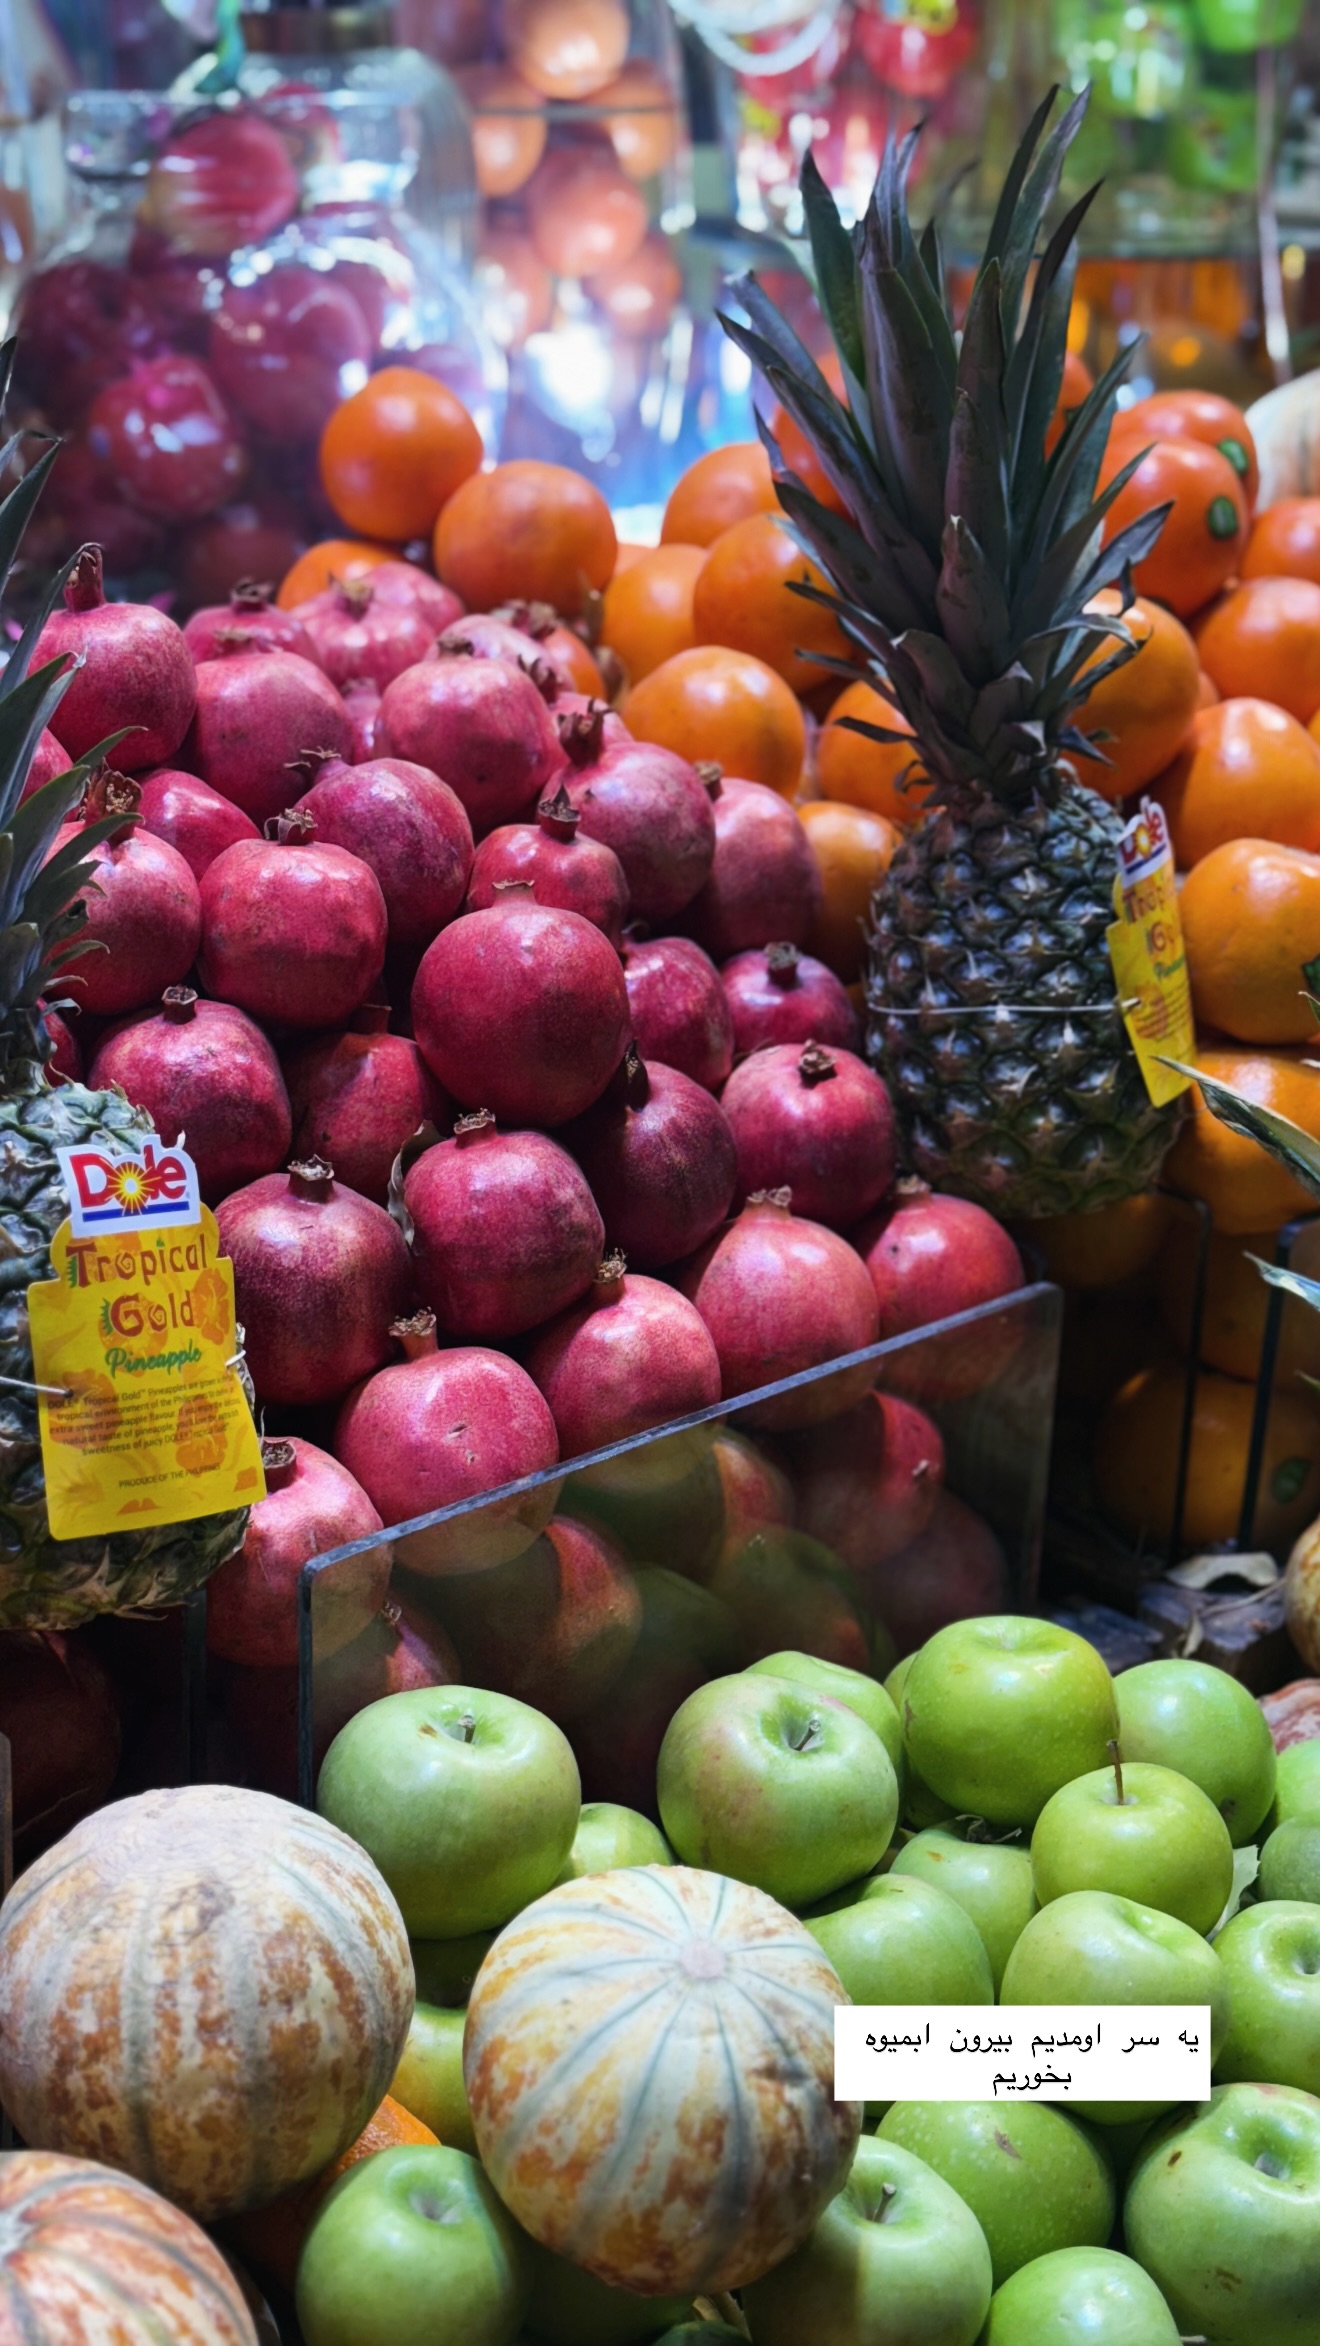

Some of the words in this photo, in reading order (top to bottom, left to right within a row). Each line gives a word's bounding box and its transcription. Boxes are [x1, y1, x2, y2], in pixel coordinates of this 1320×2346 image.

[69, 1144, 187, 1211] Dole
[66, 1234, 207, 1288] Tropical
[109, 1290, 195, 1337] Gold
[105, 1339, 202, 1378] Pineapple
